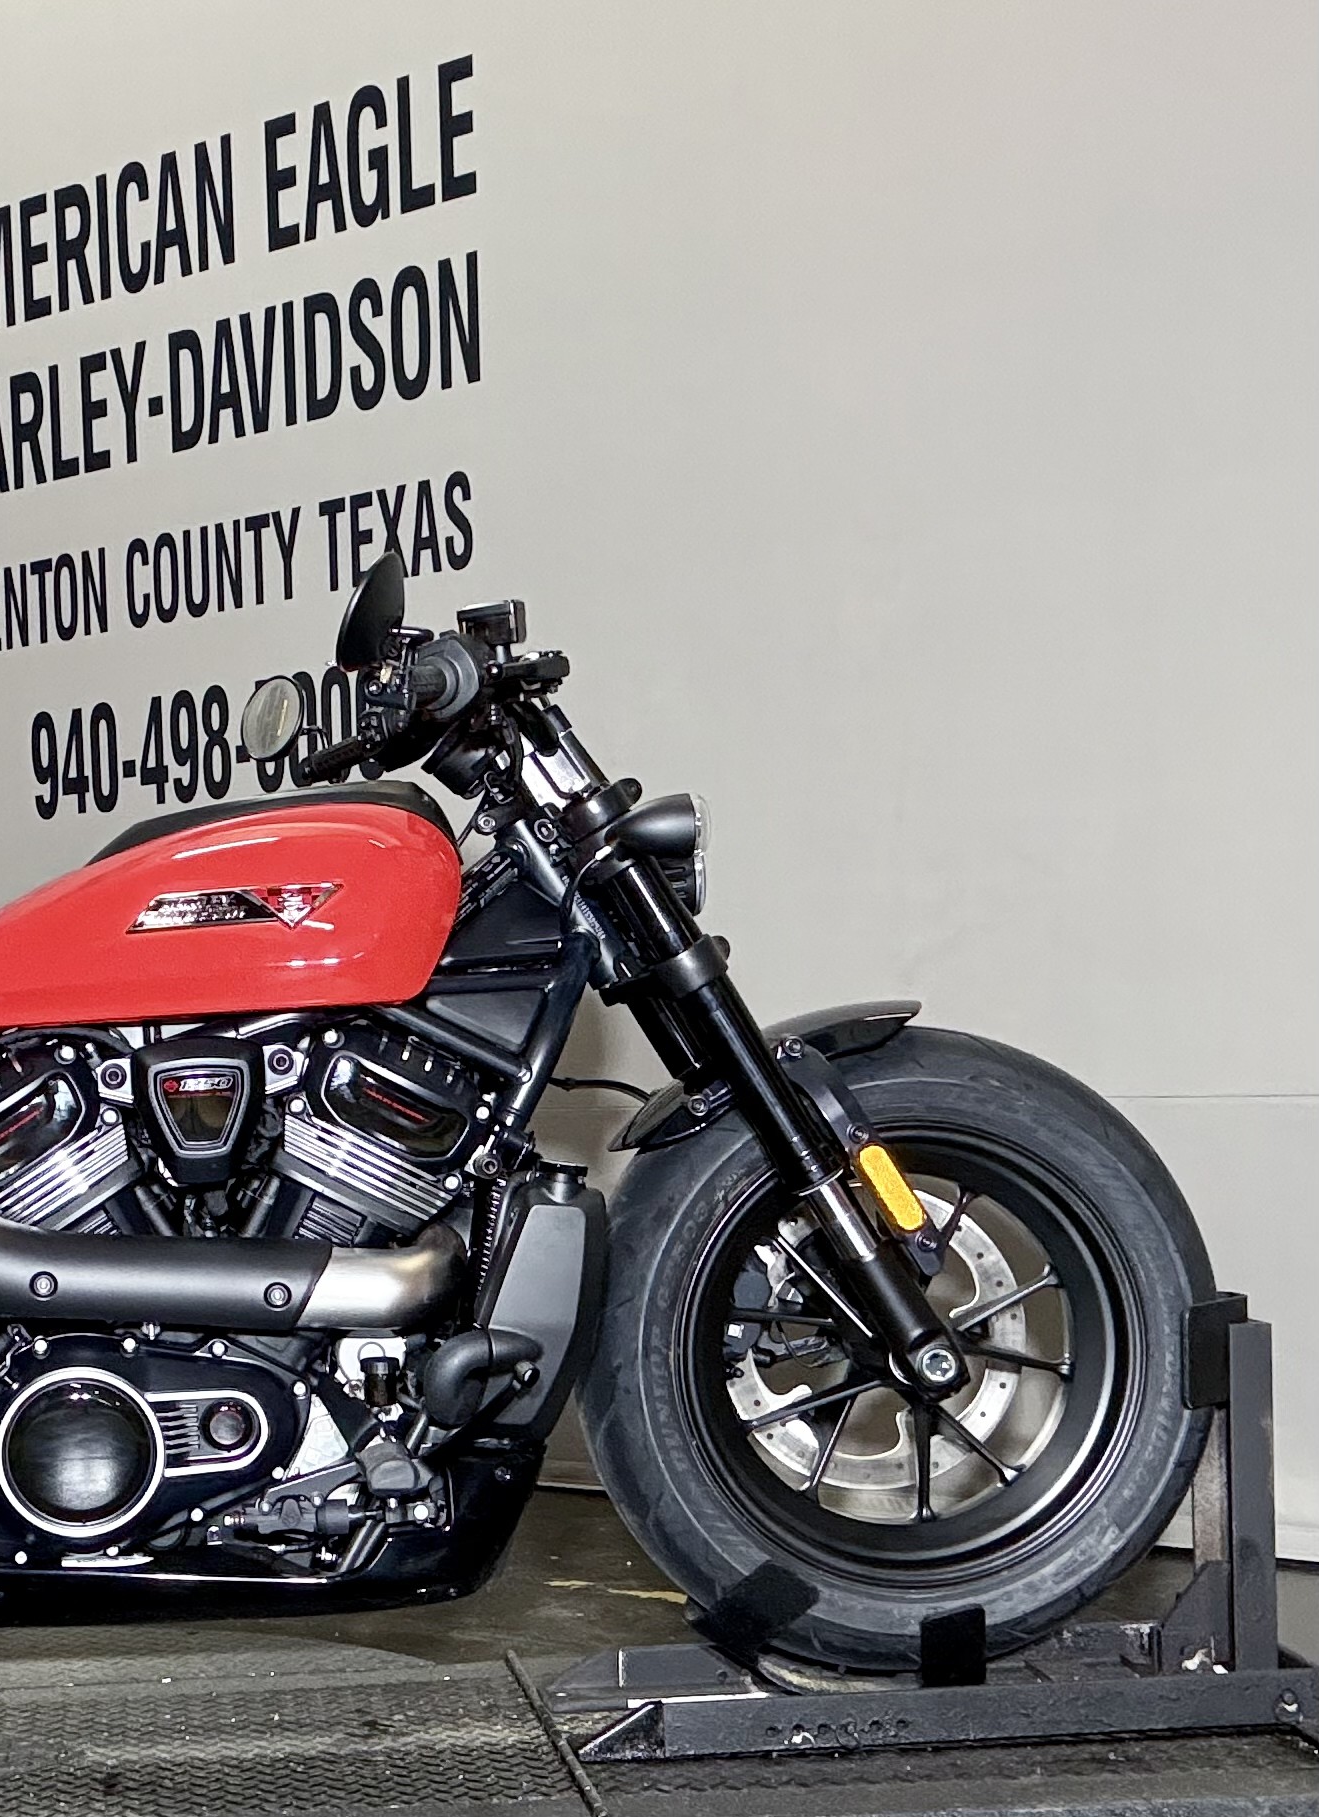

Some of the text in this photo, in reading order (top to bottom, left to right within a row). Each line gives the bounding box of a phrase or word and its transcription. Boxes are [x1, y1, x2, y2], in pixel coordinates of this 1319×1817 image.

[265, 54, 477, 253] EAGLE
[125, 506, 302, 629] COUNTY
[318, 470, 474, 592] TEXAS
